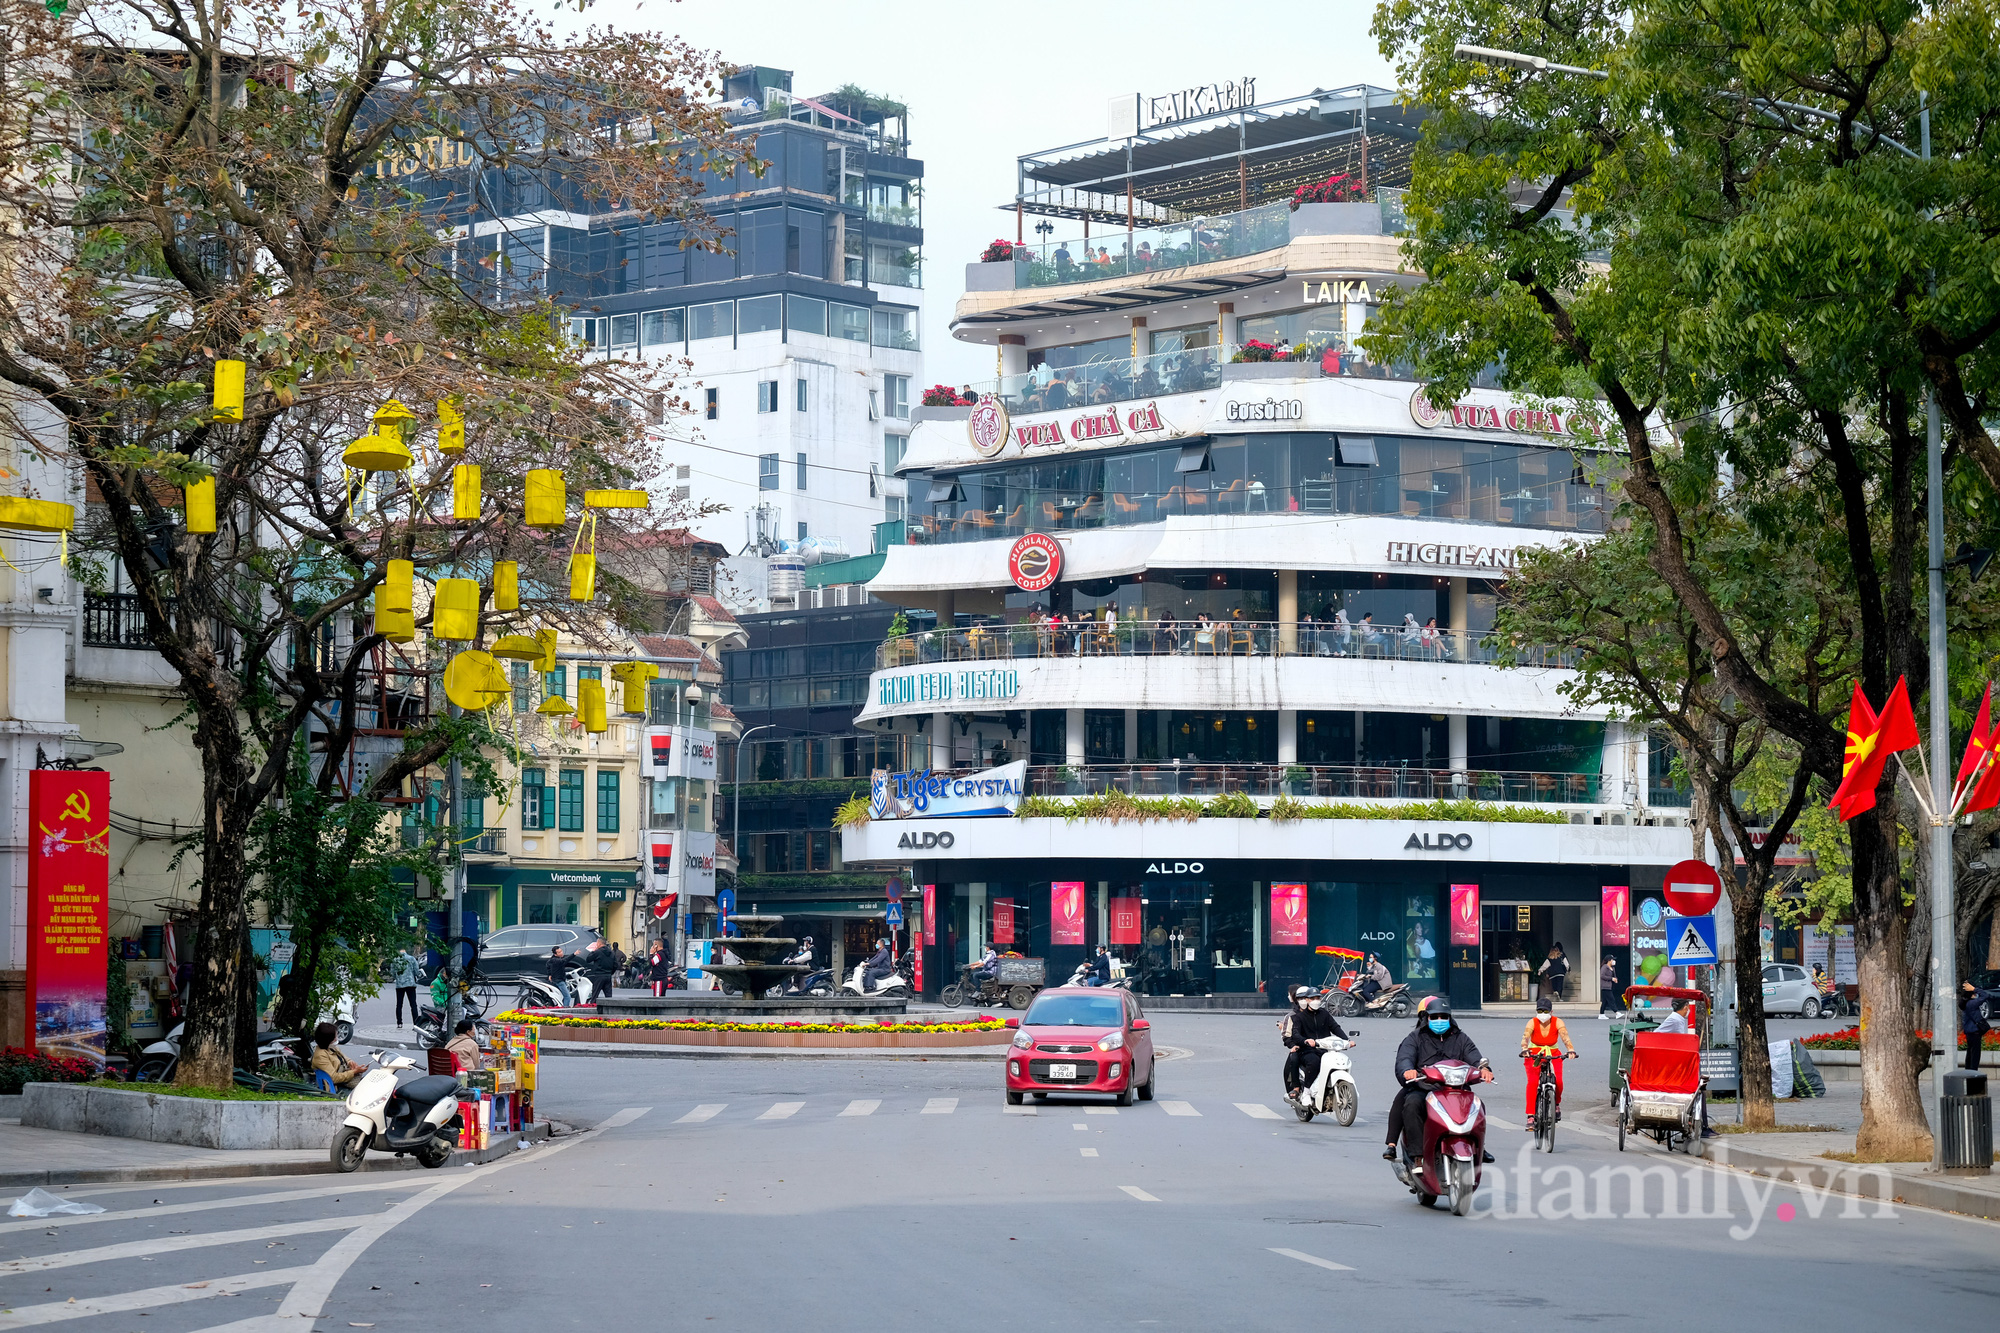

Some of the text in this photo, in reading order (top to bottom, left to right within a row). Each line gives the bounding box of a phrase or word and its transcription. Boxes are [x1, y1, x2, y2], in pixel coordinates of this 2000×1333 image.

[1147, 83, 1219, 126] LAIKA
[1222, 76, 1256, 110] Café
[1303, 281, 1372, 303] LAIKA
[1280, 399, 1302, 419] 10
[1452, 405, 1502, 429] VUA
[1016, 400, 1164, 449] VUA CHẢ CÁ
[1011, 537, 1057, 562] HIGHLANDS
[1017, 573, 1053, 589] COFFEE
[878, 669, 1017, 705] HANOI 1930 BISTRO
[893, 768, 1022, 812] Tiger CRYSTAL
[897, 831, 955, 849] ALDO
[1404, 832, 1473, 850] ALDO
[551, 872, 601, 883] Vietcombank
[1145, 862, 1204, 874] ALDO
[605, 890, 621, 898] ATM
[1360, 931, 1395, 940] ALDO
[1462, 949, 1468, 960] 1
